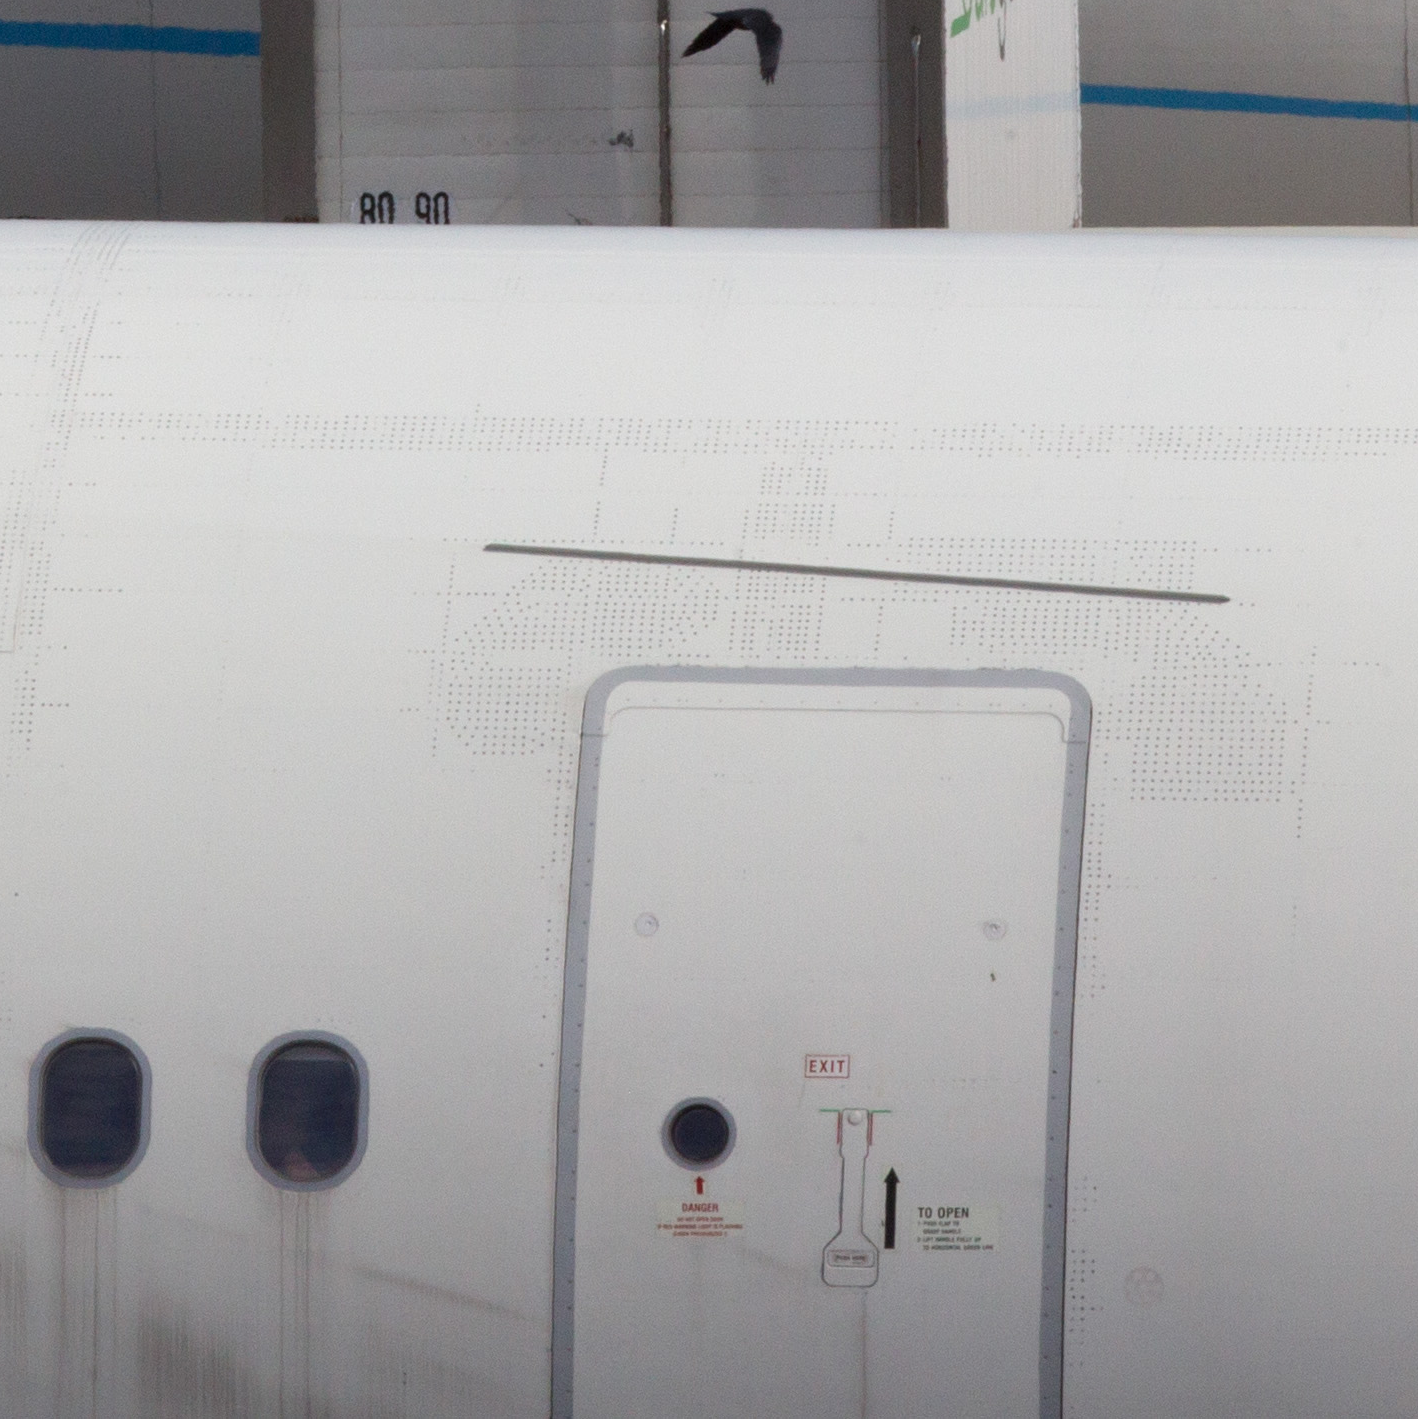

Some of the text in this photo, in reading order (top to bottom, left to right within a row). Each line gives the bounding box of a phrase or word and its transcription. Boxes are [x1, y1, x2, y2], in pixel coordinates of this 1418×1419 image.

[809, 1059, 846, 1073] EXIT
[681, 1202, 720, 1213] DANGER
[917, 1206, 969, 1219] TO OPEN
